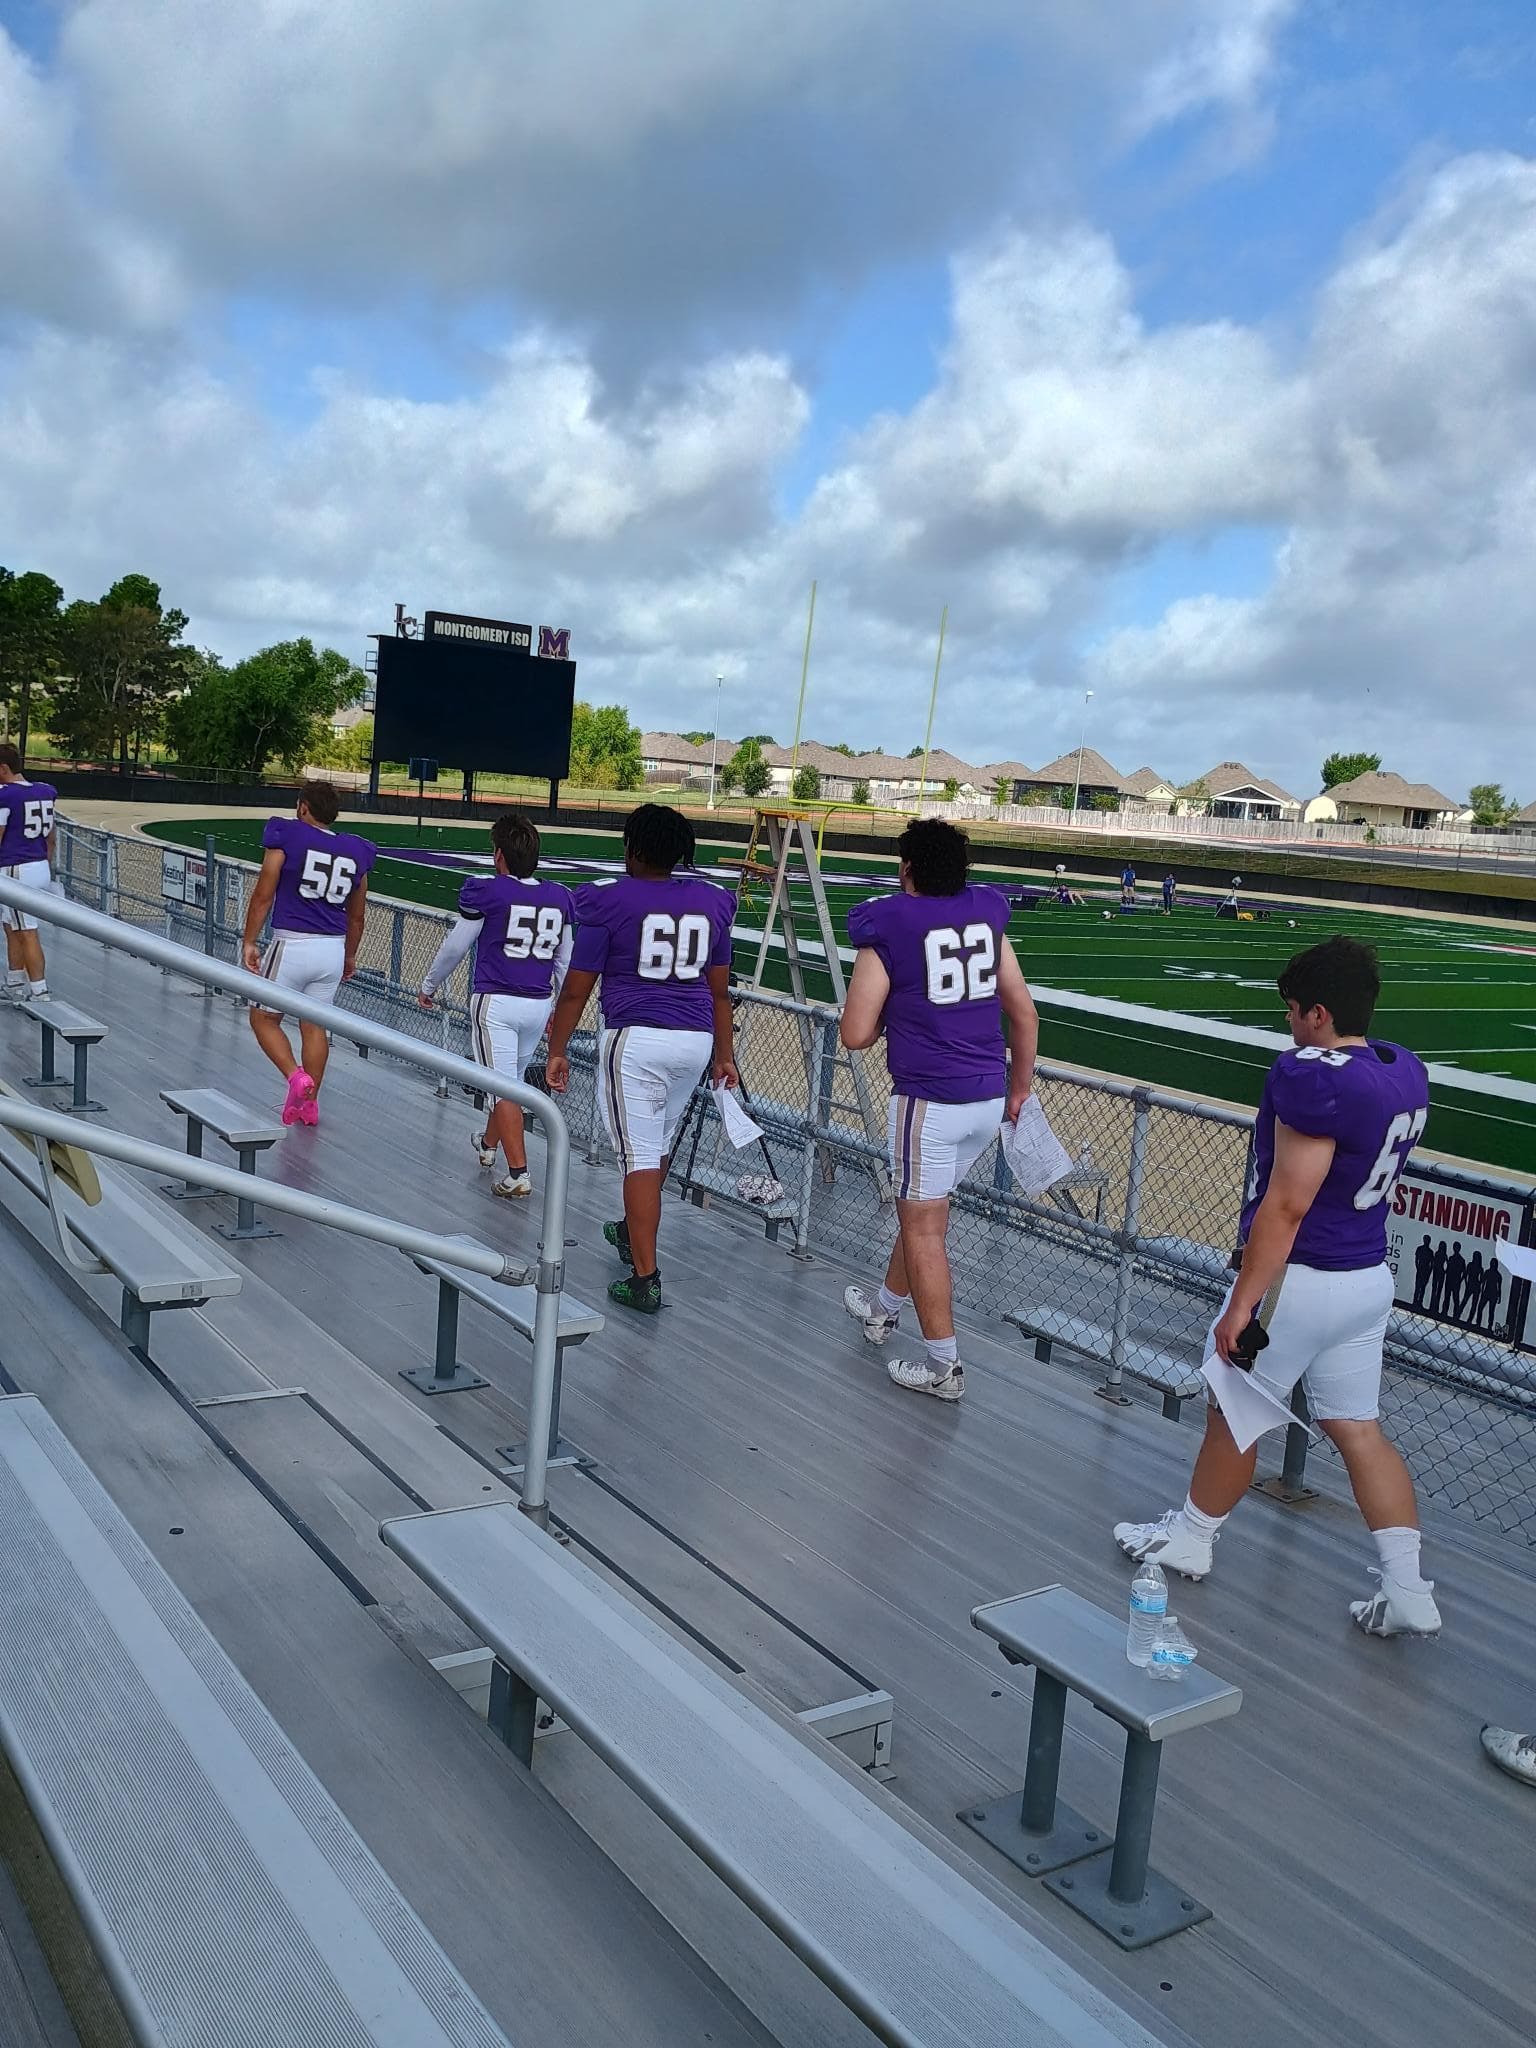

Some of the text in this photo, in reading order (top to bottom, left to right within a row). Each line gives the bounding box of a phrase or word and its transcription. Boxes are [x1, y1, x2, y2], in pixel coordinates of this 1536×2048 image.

[434, 620, 530, 647] MONTGOMERY ISD
[539, 625, 571, 660] M
[24, 800, 54, 839] 55
[299, 849, 357, 904] 56
[503, 904, 563, 960] 58
[637, 913, 710, 981] 60
[924, 923, 997, 1005] 62
[1295, 1046, 1353, 1067] 63
